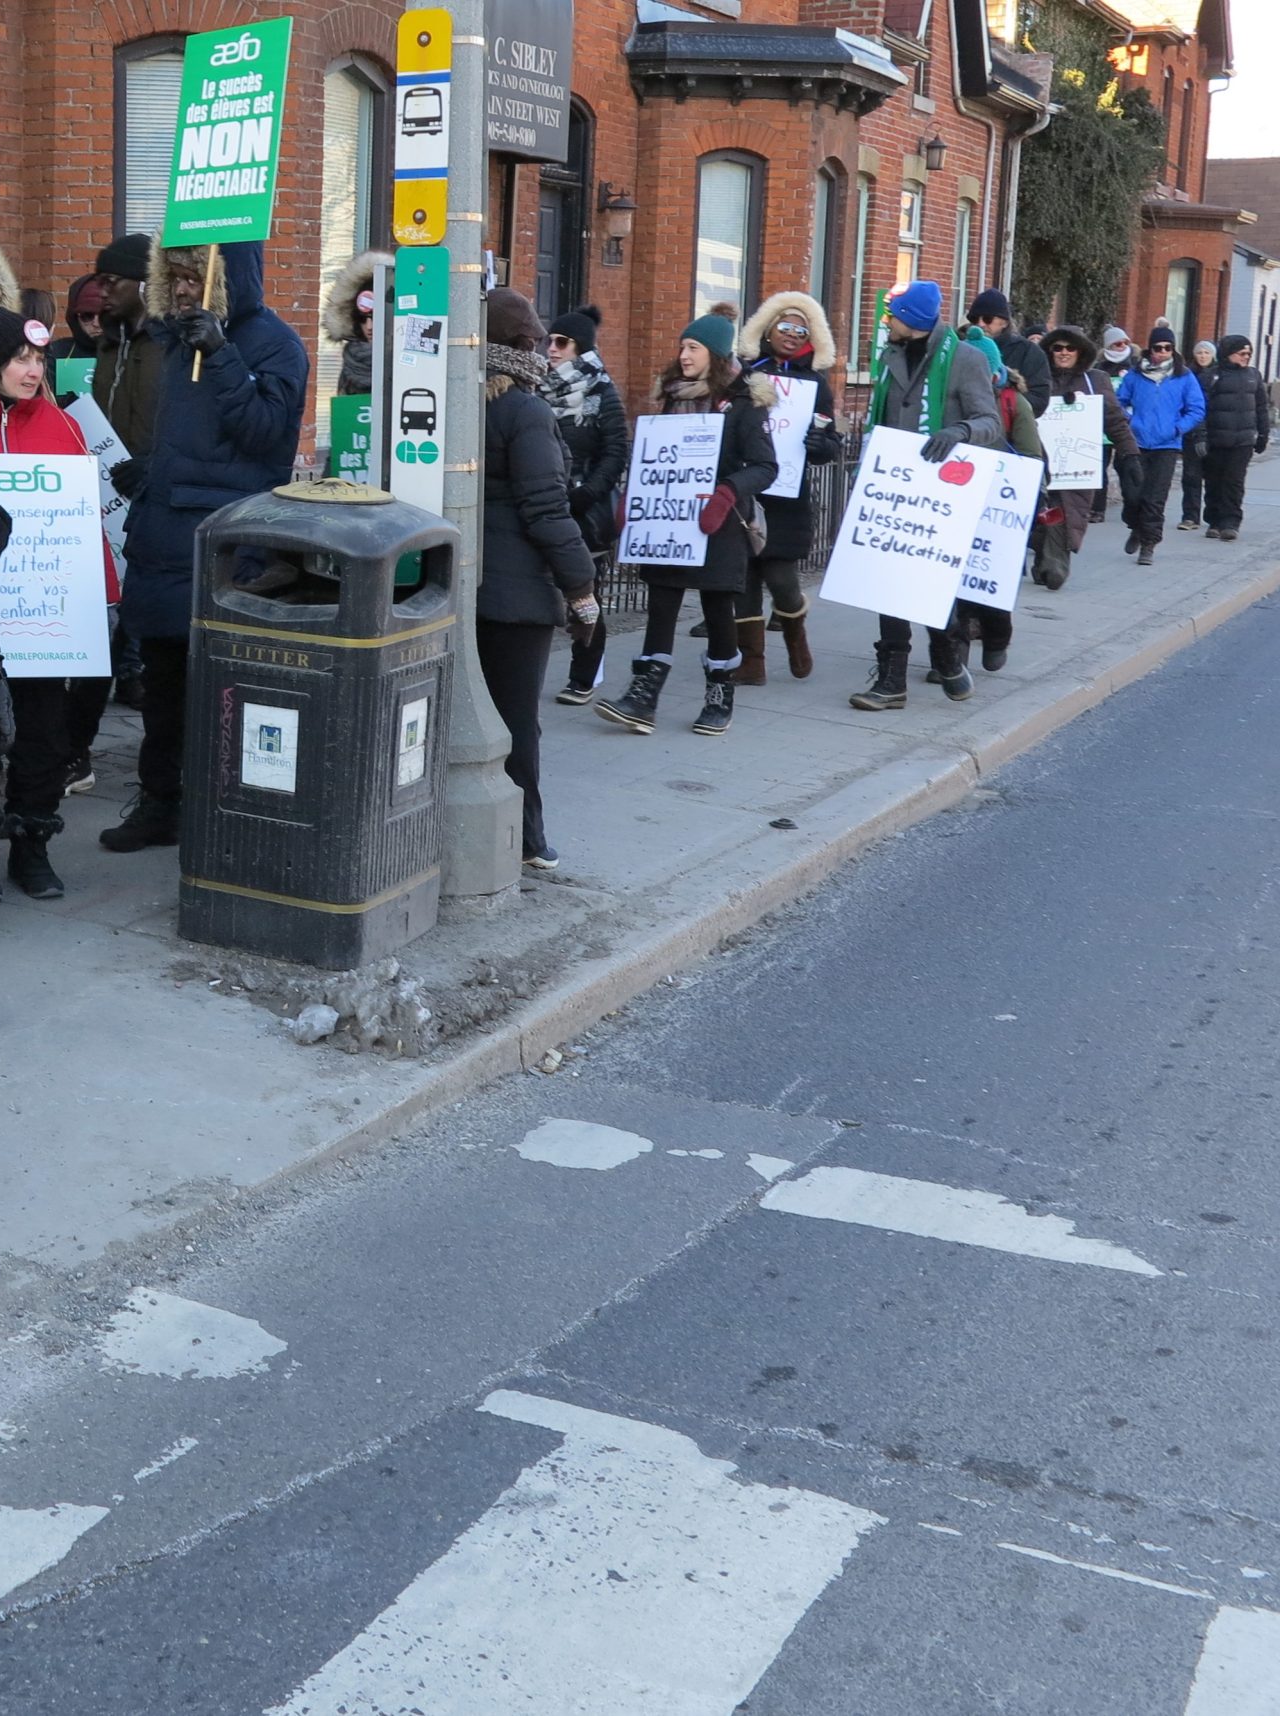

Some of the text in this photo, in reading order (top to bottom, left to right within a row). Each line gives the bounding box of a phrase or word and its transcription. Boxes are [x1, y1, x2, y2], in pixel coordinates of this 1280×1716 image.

[510, 41, 557, 77] SIBLEY
[202, 71, 263, 100] Le succès
[501, 73, 518, 90] AND
[519, 78, 564, 100] GYNECOLOGY
[186, 91, 274, 124] des élèves est
[505, 98, 535, 122] STEET
[536, 105, 561, 128] WEST
[178, 116, 273, 171] NON
[174, 166, 268, 202] NÉGOCIABLE
[180, 216, 253, 231] ENSEMBLEPOURAGIR.CA
[352, 432, 367, 450] Le
[396, 440, 439, 464] GO
[640, 438, 678, 464] Les
[340, 451, 362, 468] des
[873, 455, 914, 482] Les
[640, 466, 714, 498] coupures
[1000, 478, 1017, 500] à
[627, 496, 704, 522] BLESSENT
[863, 483, 953, 517] Coupures
[858, 505, 938, 540] blessent
[980, 506, 1030, 532] ATION
[851, 526, 962, 568] L'éducation
[3, 555, 61, 574] luttent
[44, 584, 68, 595] vos
[0, 596, 65, 620] enfants!
[232, 644, 310, 668] LITTER
[248, 752, 292, 768] Hamilton
